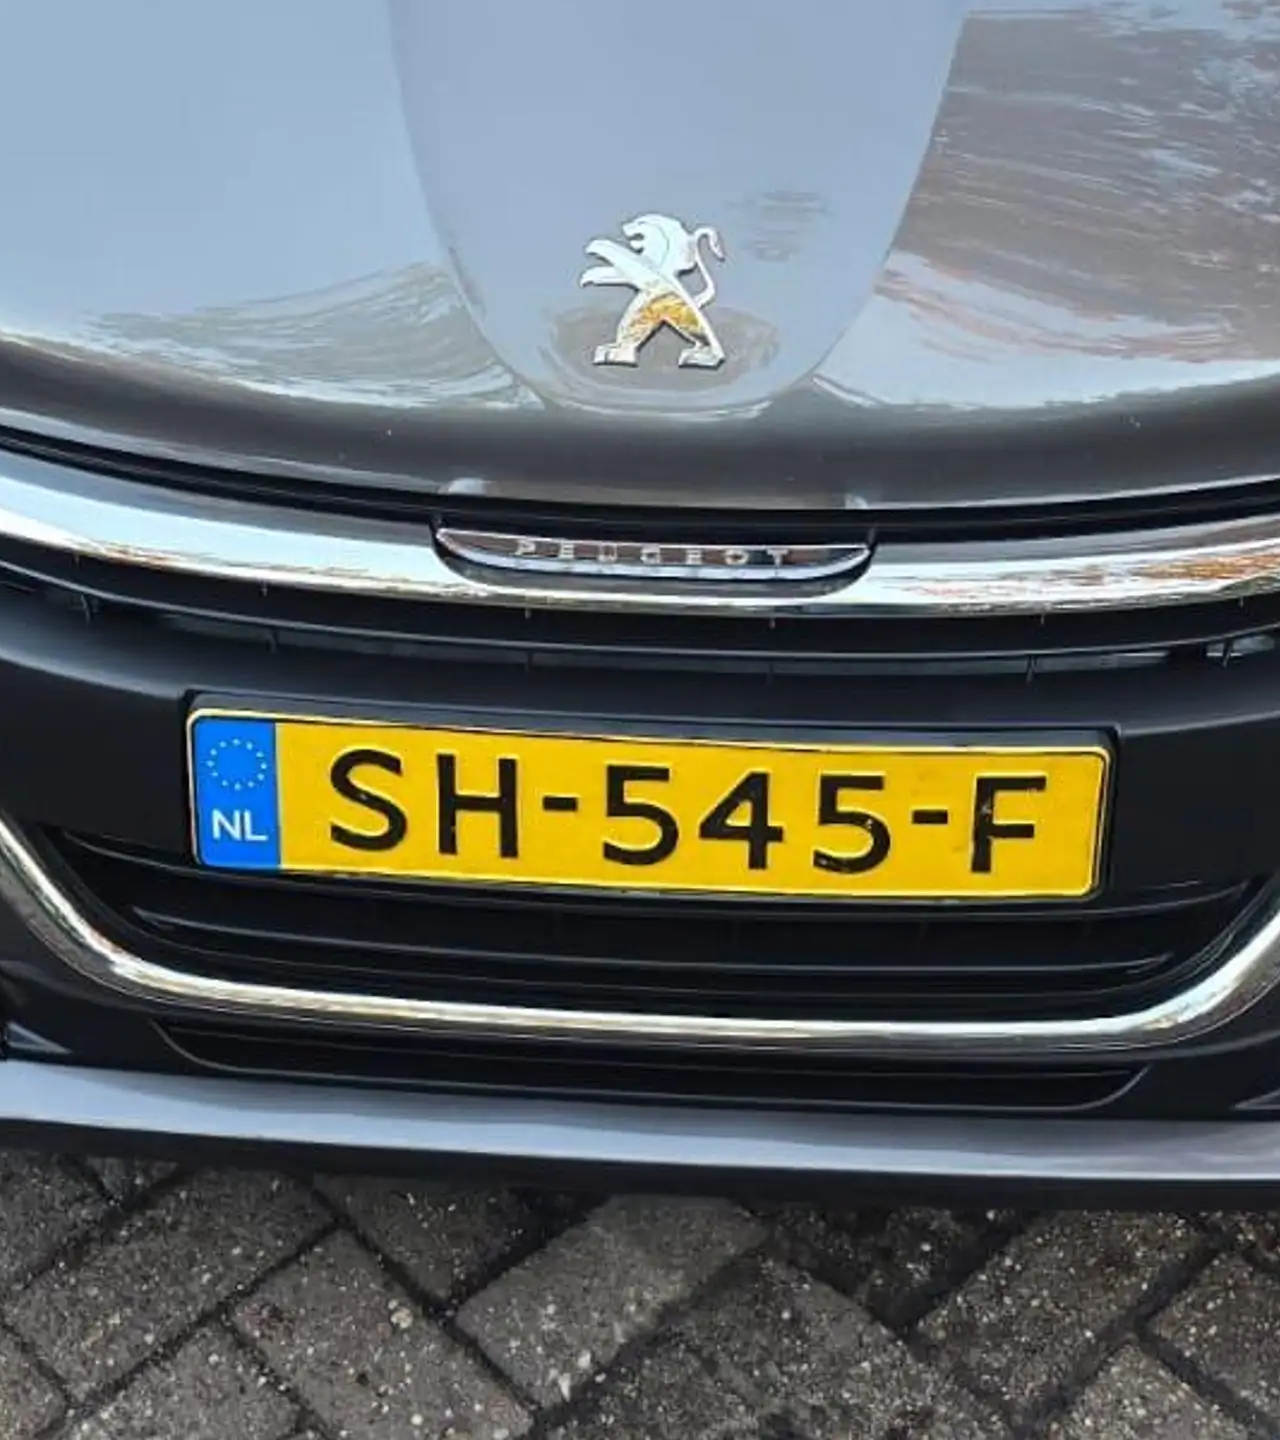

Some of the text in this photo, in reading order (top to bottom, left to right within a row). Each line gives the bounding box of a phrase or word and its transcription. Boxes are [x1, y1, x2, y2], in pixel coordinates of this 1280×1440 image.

[515, 540, 789, 567] PEUGEOT
[211, 810, 268, 843] NL
[329, 747, 1047, 875] SH-545-F
